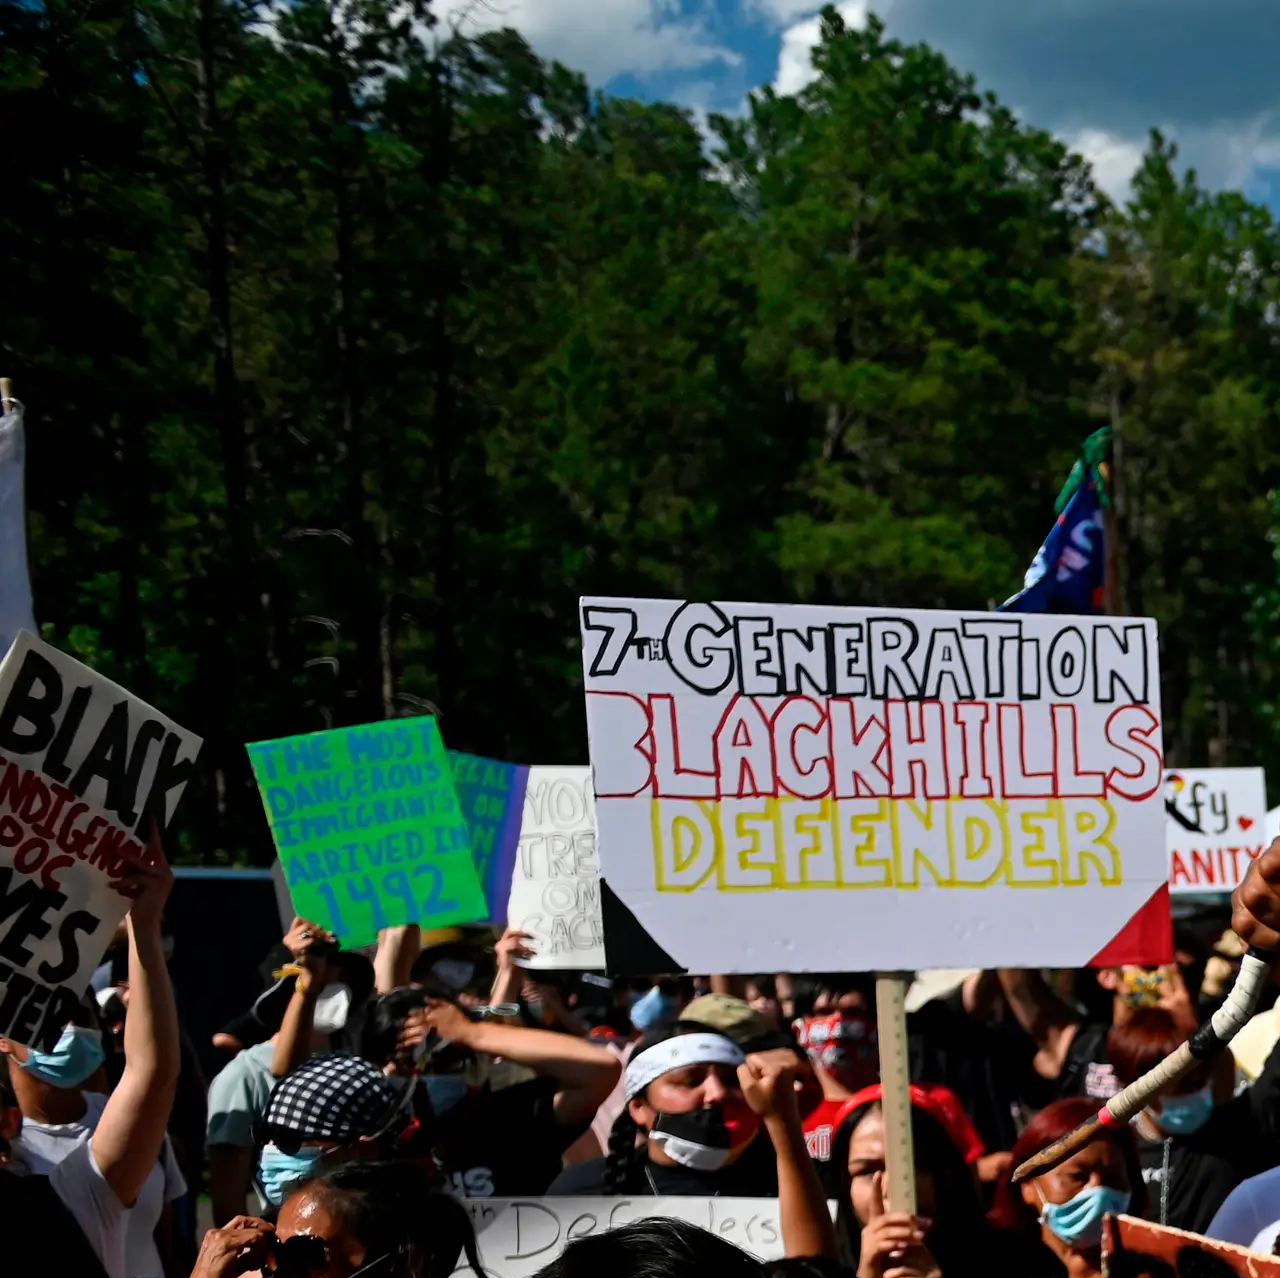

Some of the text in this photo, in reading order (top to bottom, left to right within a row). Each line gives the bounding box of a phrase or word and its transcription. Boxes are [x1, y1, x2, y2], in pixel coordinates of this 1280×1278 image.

[0, 649, 192, 843] BLACK
[253, 722, 436, 781] THE MOST
[266, 759, 442, 818] DANGEROUS
[273, 784, 457, 848] IMMIGRANTS
[1188, 780, 1230, 835] fy
[288, 830, 424, 887] ARRIVED
[431, 825, 472, 854] IN
[518, 832, 598, 880] TRE
[651, 795, 1123, 893] DEFENDER
[1170, 845, 1263, 886] ANITY
[316, 864, 461, 937] 1492
